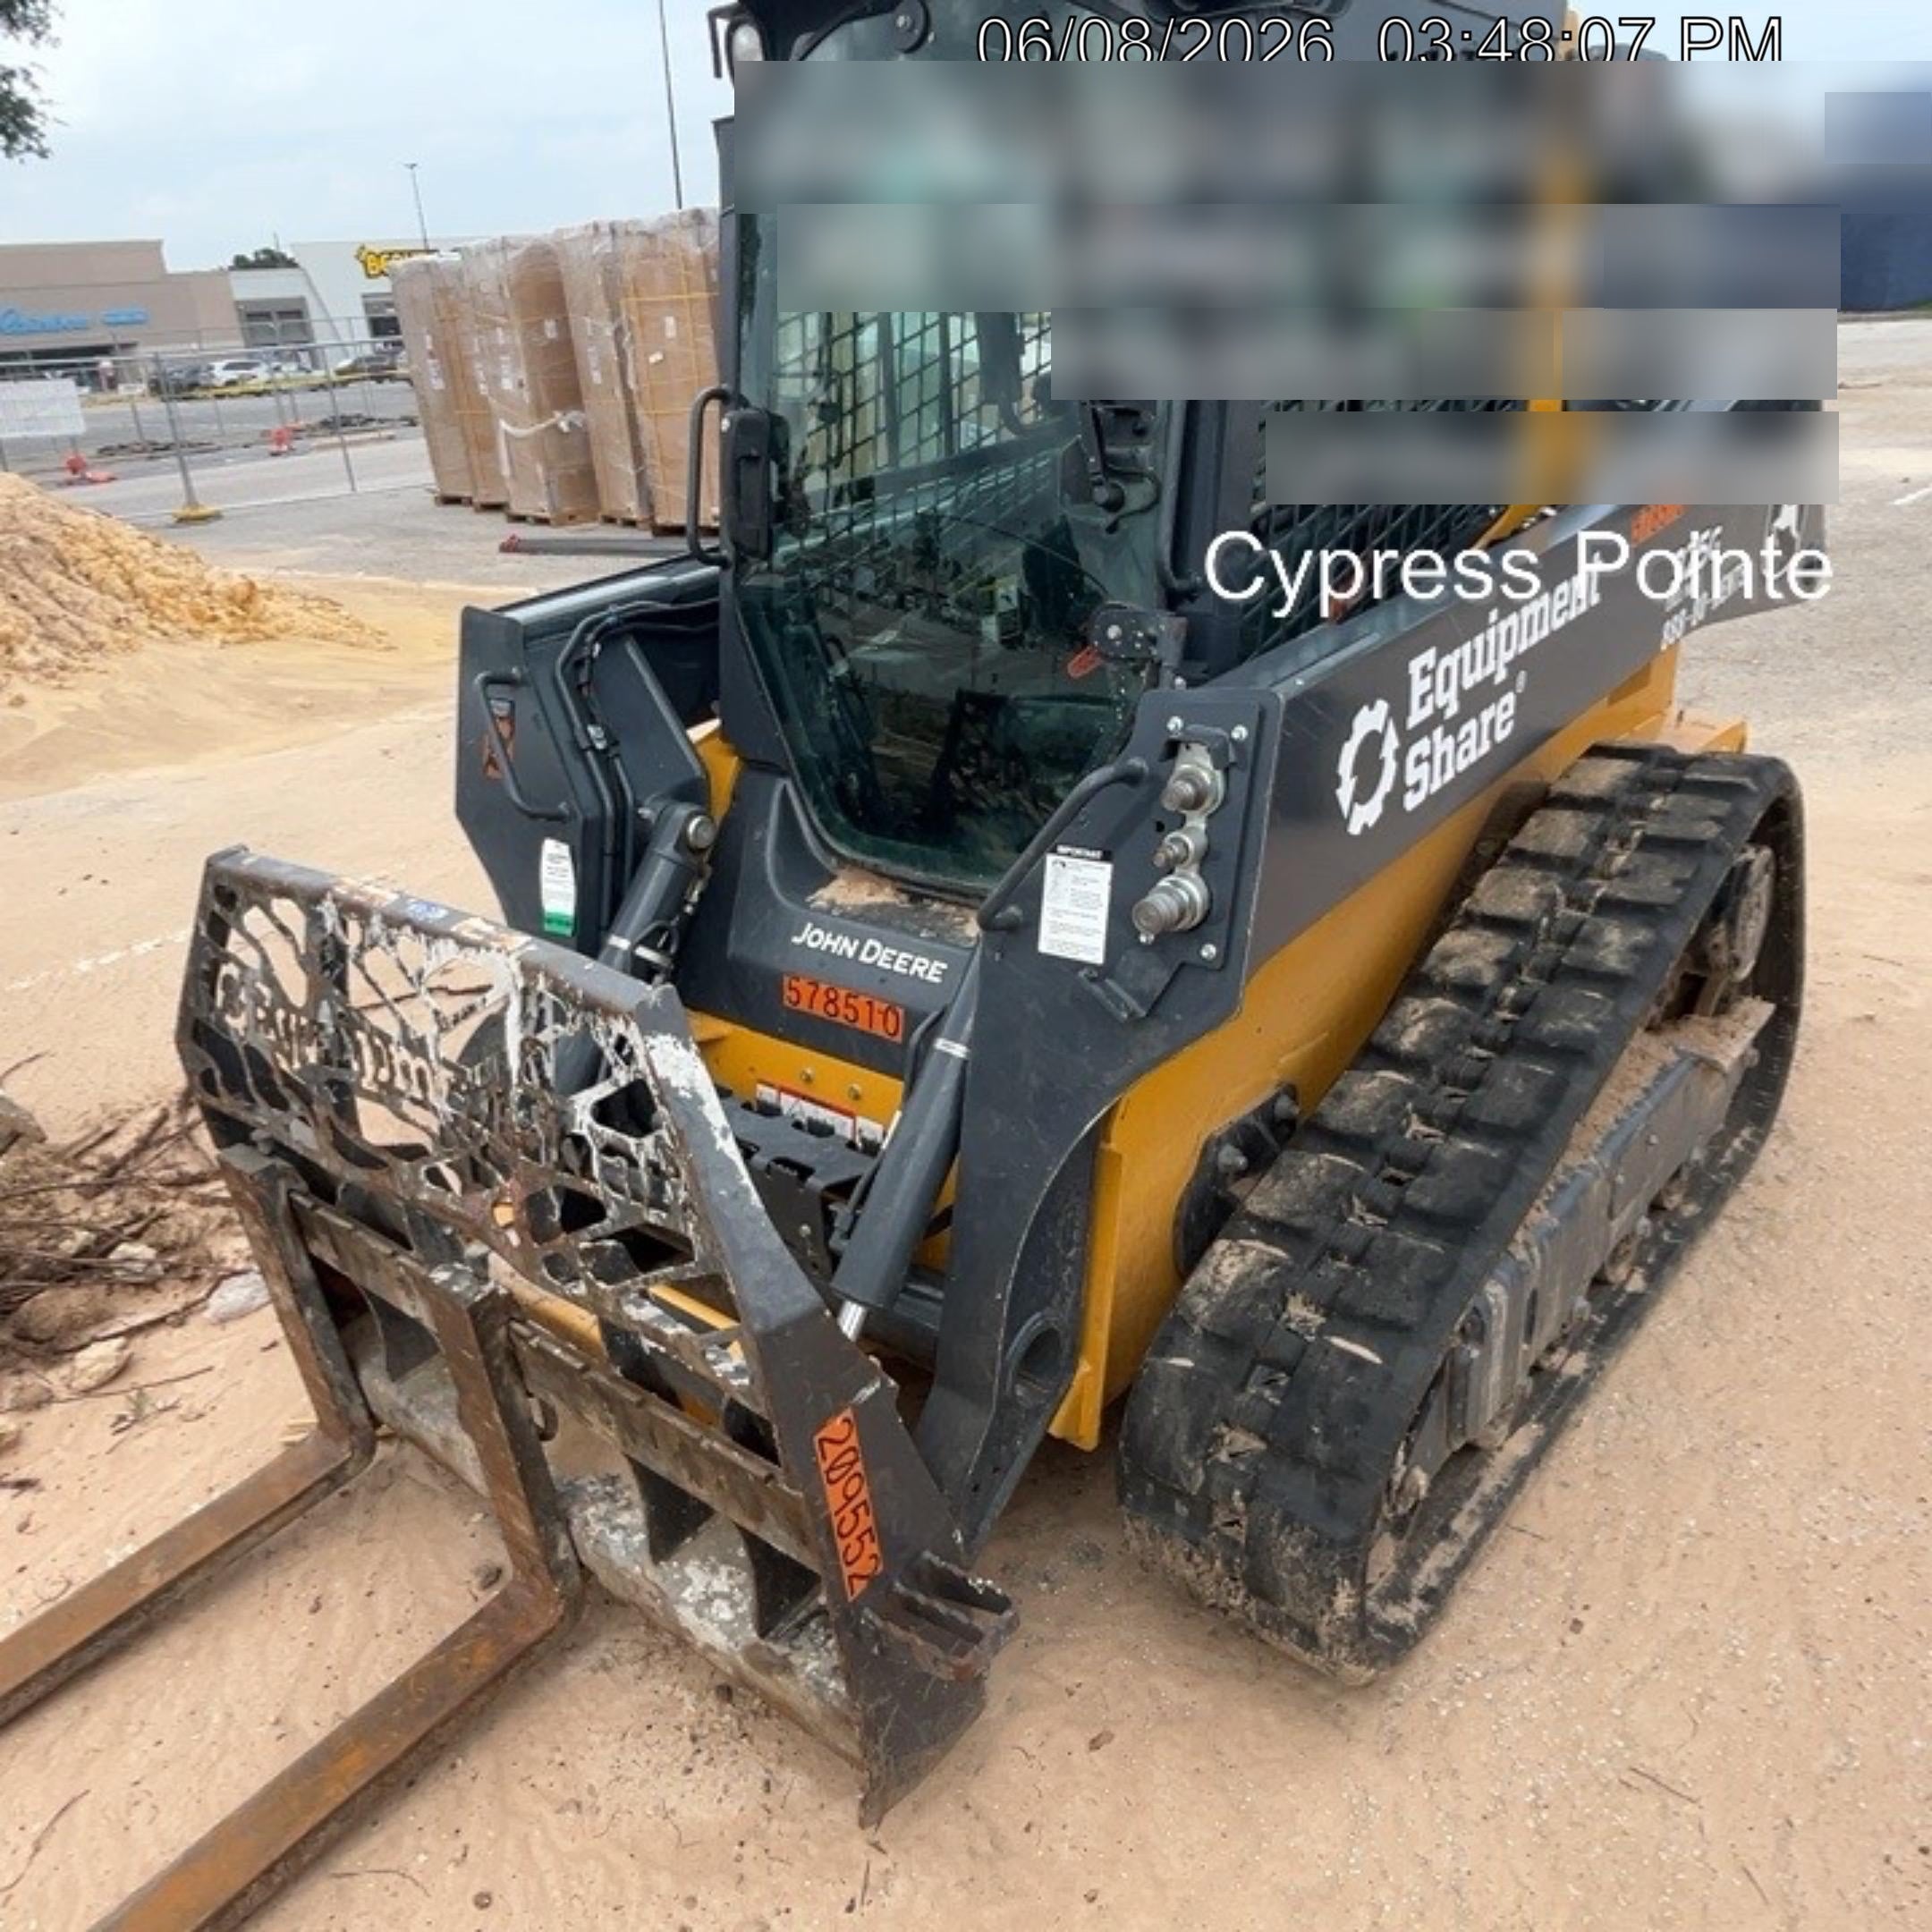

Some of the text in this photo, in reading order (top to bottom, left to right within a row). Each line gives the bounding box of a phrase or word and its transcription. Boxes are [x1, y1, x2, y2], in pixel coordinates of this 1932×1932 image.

[1406, 551, 1601, 730] Equipment
[1402, 691, 1516, 812] Share
[787, 975, 900, 1038] 578510
[791, 922, 948, 983] JOHN DEERE
[818, 1417, 878, 1597] 209552
